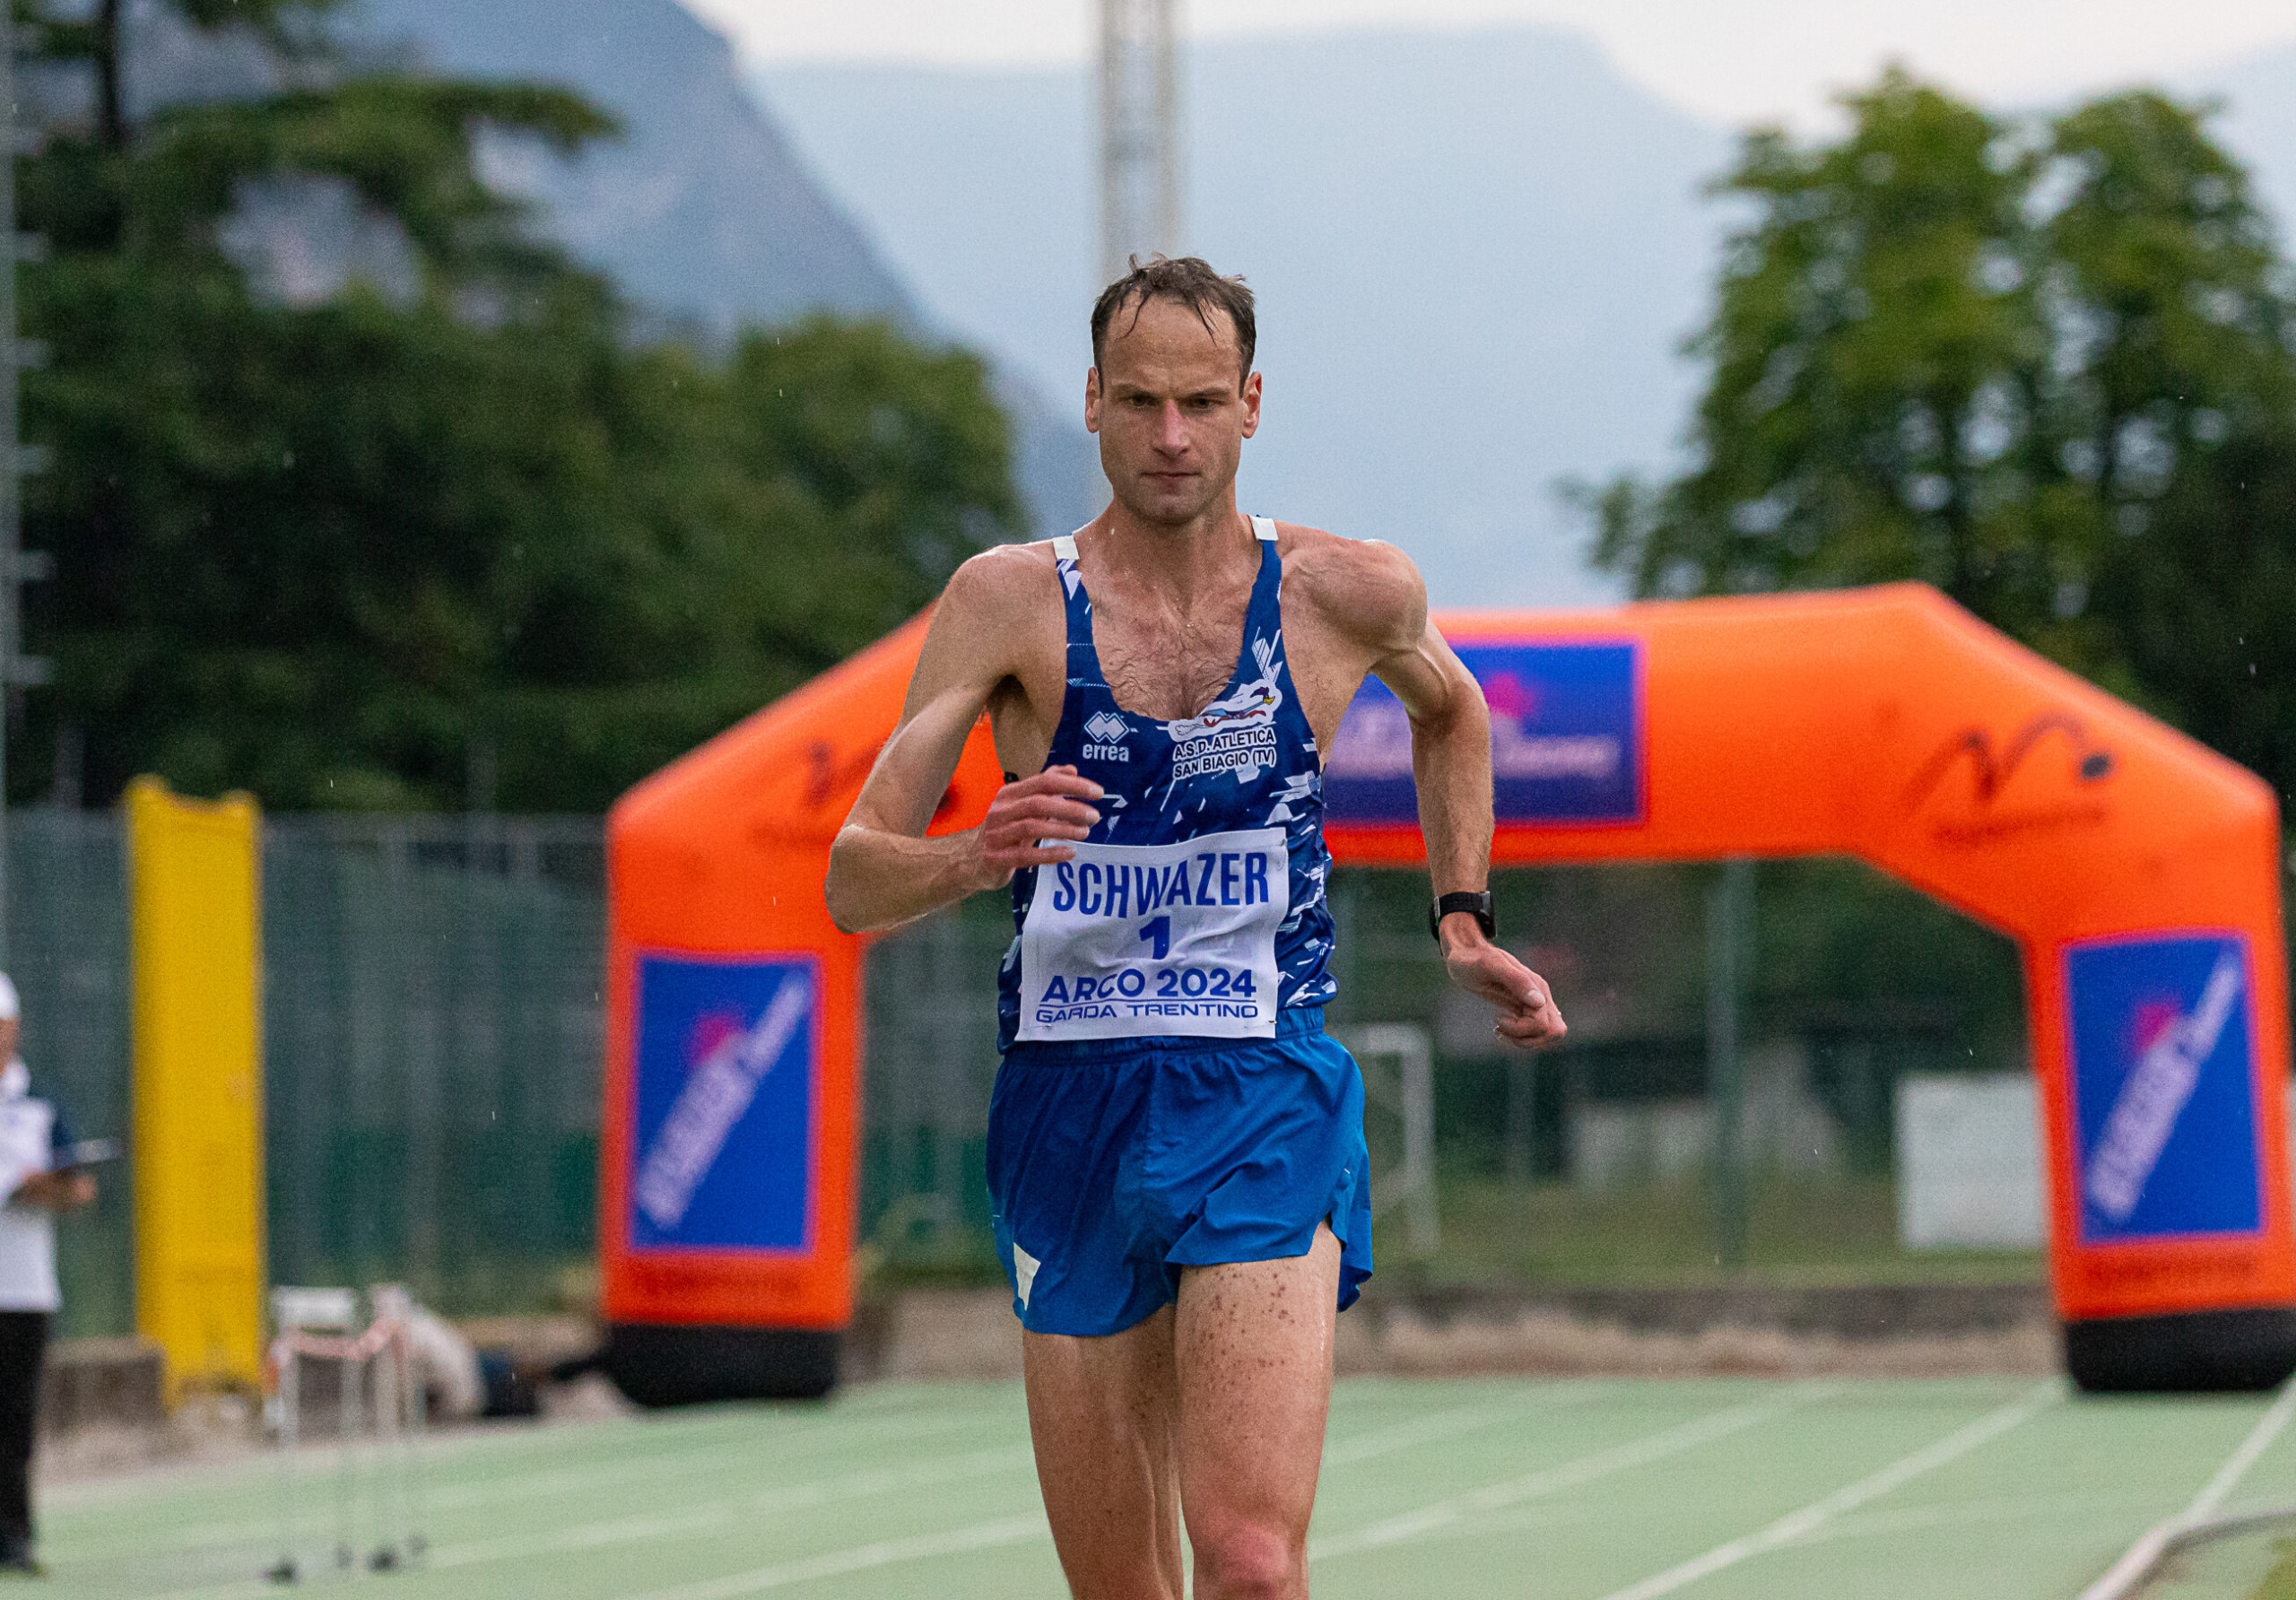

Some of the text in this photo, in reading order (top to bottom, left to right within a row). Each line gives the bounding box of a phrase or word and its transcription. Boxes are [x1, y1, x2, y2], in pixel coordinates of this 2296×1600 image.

[1174, 731, 1274, 760] A.S.D. ATLETICA
[1174, 749, 1276, 778] SAN BIAGIO (TV)
[1053, 853, 1268, 917] SCHWAZER
[1139, 916, 1171, 960] 1
[1041, 968, 1257, 1004] ARCO 2024
[1036, 1004, 1258, 1023] GARDA TRENTINO
